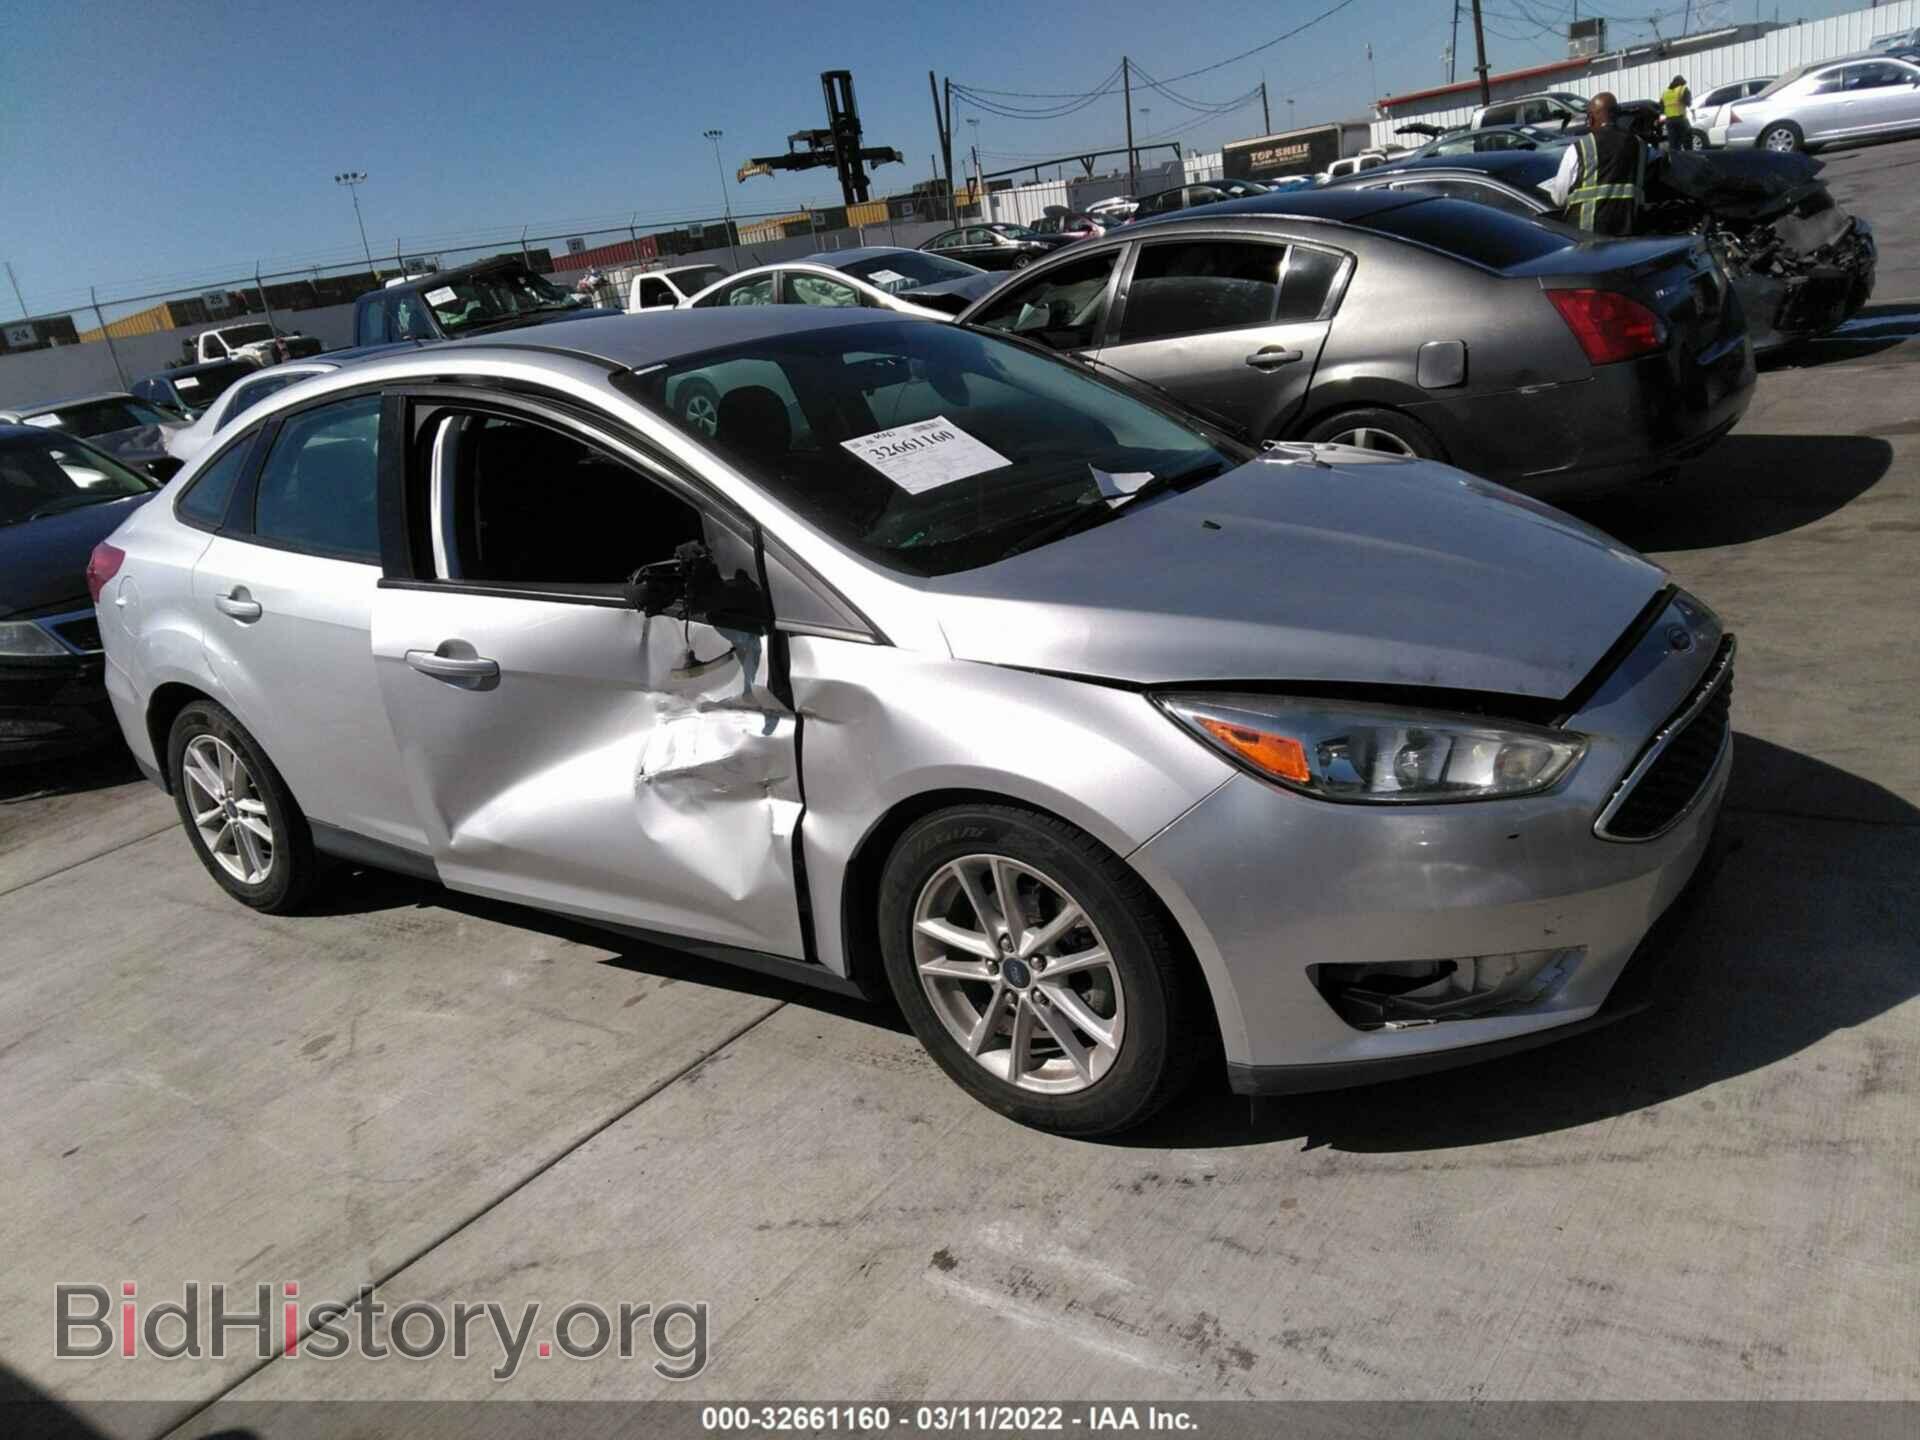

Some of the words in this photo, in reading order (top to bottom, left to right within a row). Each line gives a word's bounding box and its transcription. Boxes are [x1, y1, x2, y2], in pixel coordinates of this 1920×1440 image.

[1250, 150, 1273, 162] TOP
[1274, 142, 1310, 157] SHELF
[208, 294, 224, 305] 25
[11, 328, 29, 342] 24
[869, 430, 955, 460] 32661160
